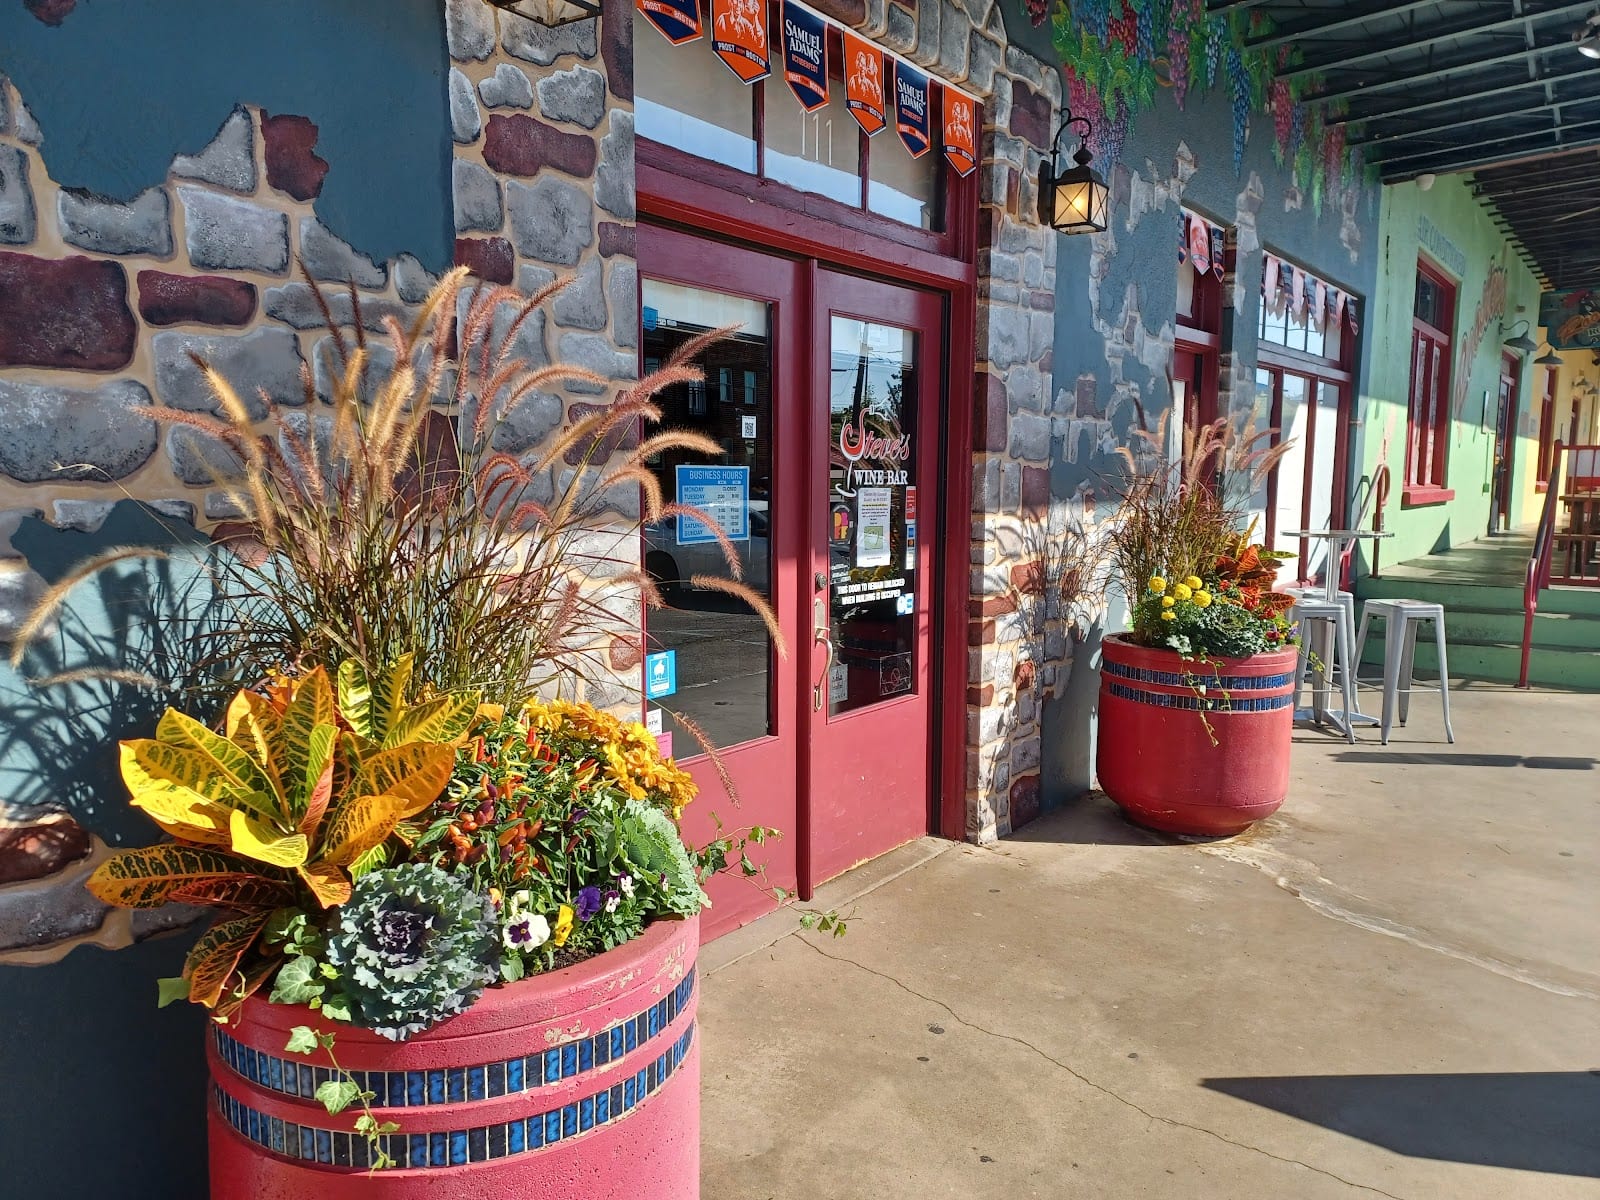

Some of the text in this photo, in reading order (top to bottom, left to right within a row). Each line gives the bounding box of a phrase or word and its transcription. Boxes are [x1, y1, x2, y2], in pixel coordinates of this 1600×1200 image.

[674, 10, 697, 31] BOSTON
[786, 19, 823, 53] SAMUEL
[717, 41, 735, 53] PROST
[746, 49, 766, 69] BOSTON
[789, 36, 820, 65] ADAMS
[791, 54, 818, 74] OCTOBERFEST
[897, 76, 926, 106] SAMUEL
[900, 92, 924, 117] ADAMS
[799, 108, 832, 166] 111
[690, 471, 743, 480] BUSINESS HOURS
[853, 470, 909, 486] WINE BAR
